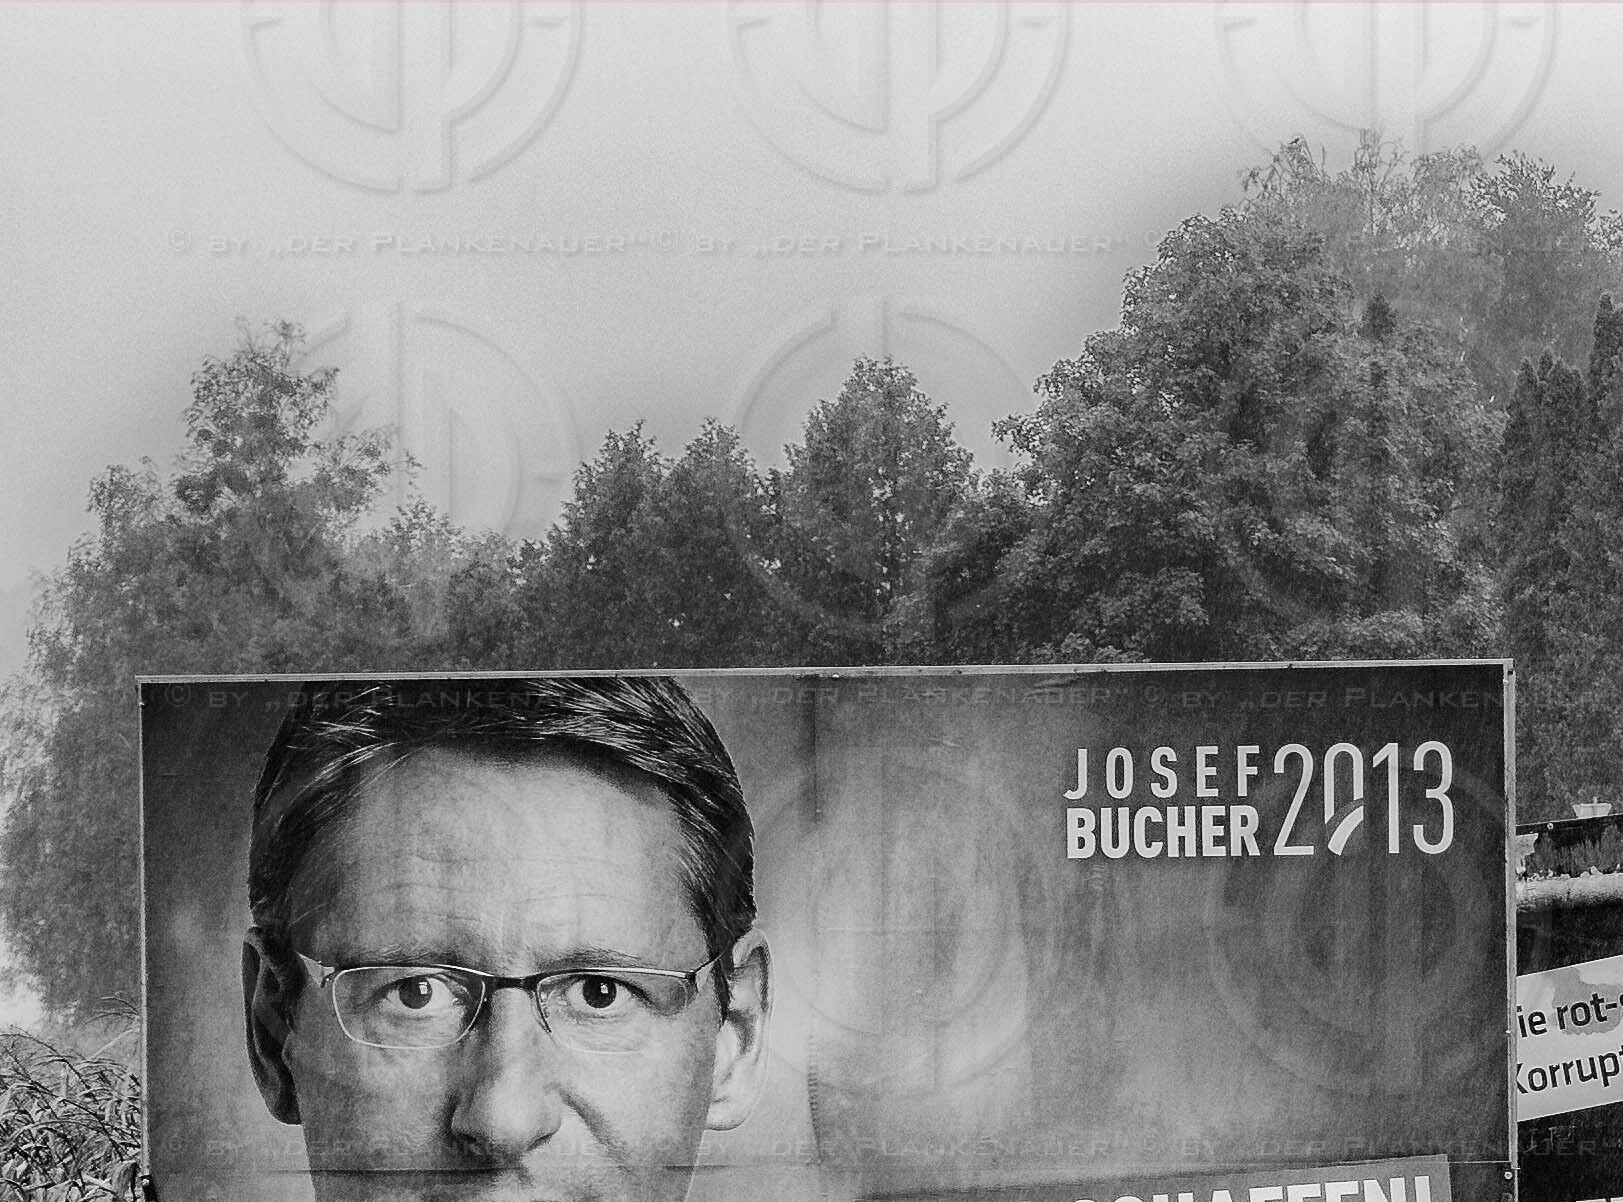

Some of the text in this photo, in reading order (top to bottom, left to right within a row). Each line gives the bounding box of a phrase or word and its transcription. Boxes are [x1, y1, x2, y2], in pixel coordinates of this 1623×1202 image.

[1063, 744, 1260, 800] JOSEF
[1273, 740, 1455, 856] 2013
[1066, 805, 1260, 859] BUCHER
[1517, 1005, 1548, 1038] ie
